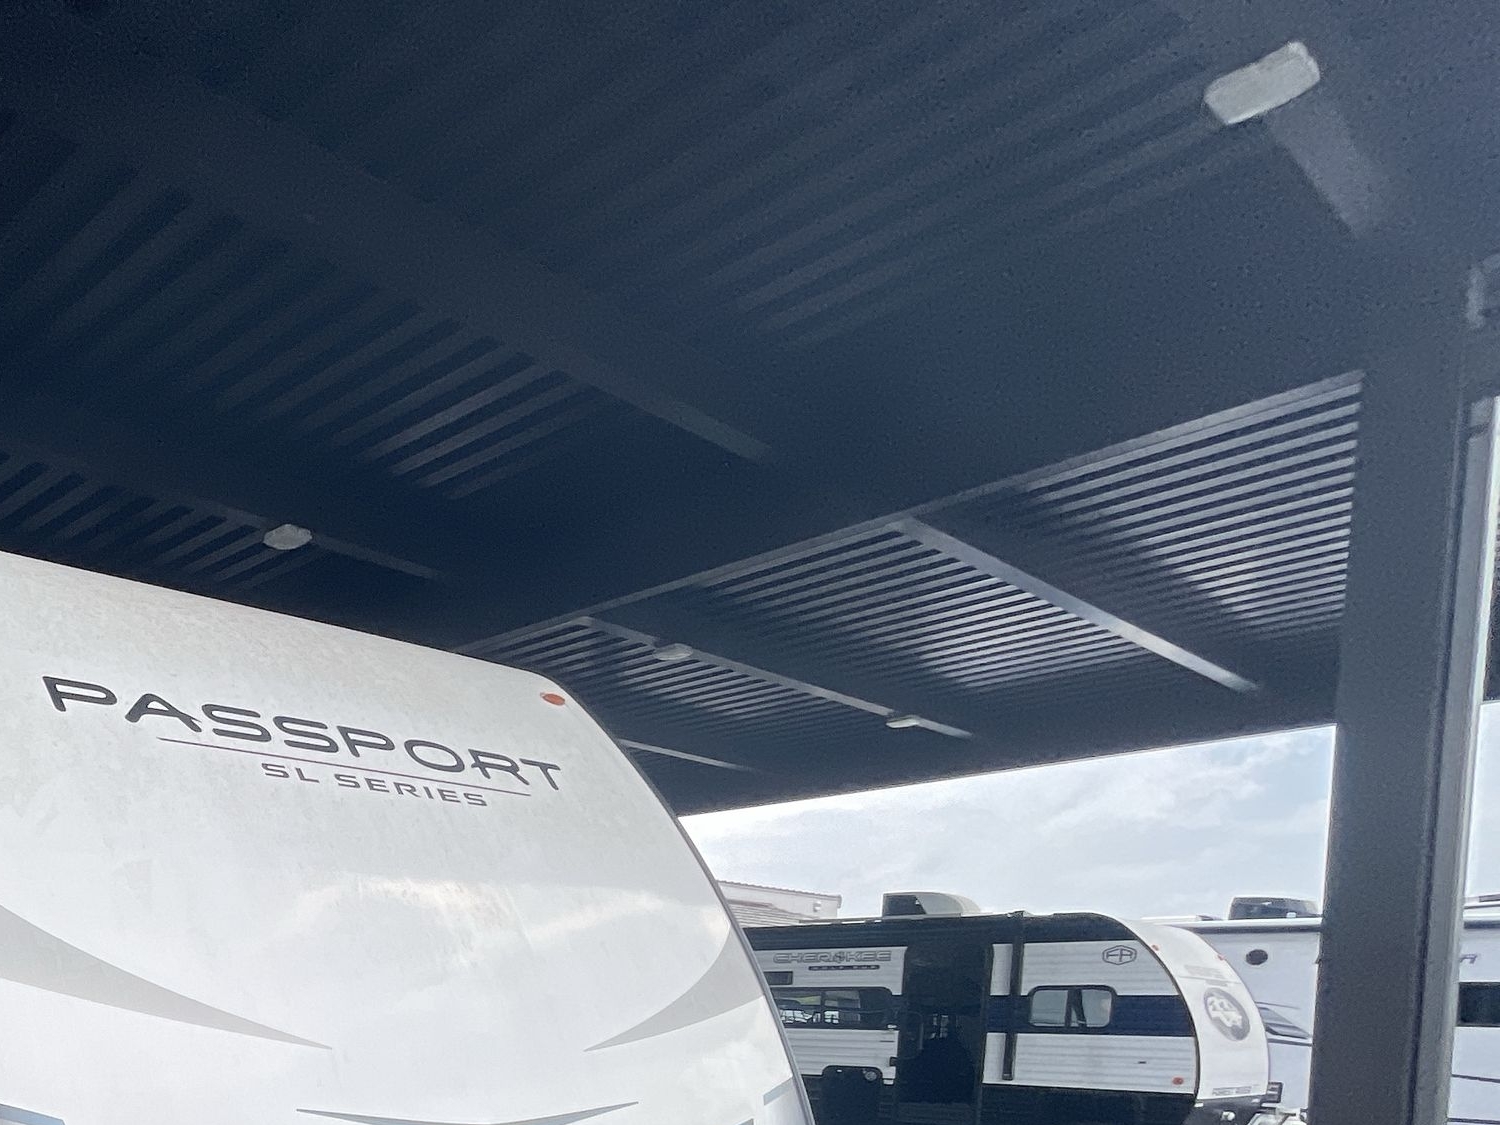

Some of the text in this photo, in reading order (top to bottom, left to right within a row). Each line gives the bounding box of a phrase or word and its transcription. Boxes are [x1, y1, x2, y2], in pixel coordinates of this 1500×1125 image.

[42, 675, 561, 791] PASSPORT
[261, 761, 487, 806] SL SERIES
